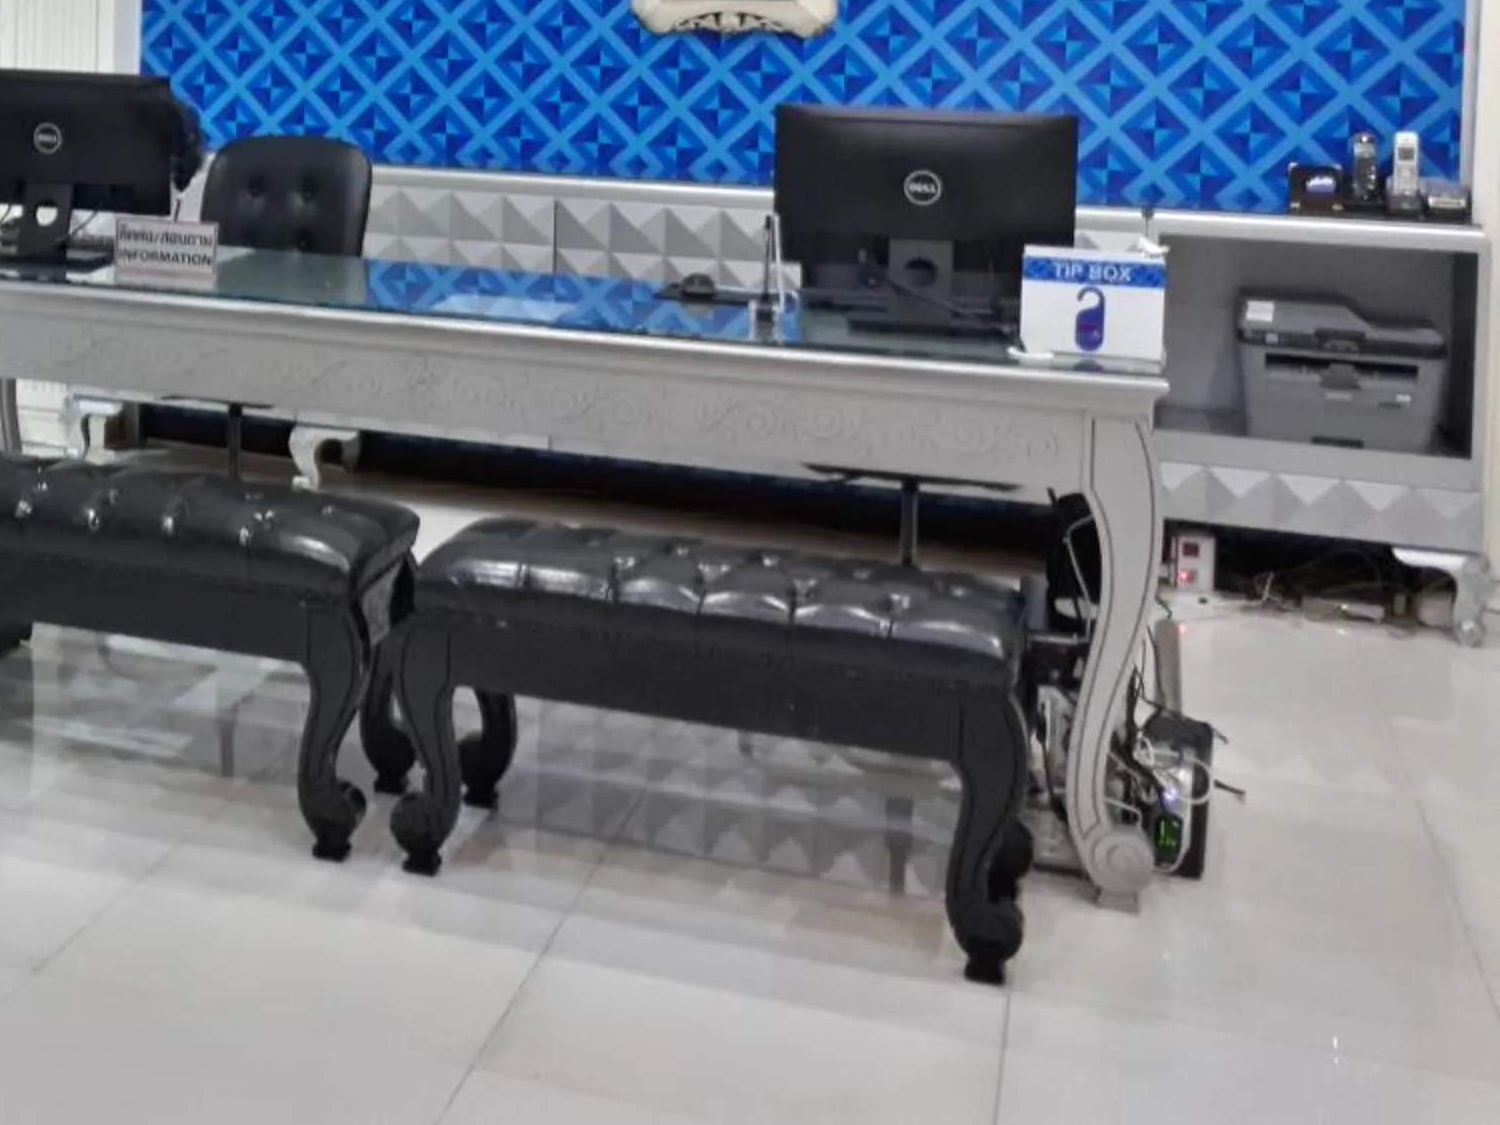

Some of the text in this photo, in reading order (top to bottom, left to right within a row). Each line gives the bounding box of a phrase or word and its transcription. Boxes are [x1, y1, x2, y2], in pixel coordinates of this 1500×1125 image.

[118, 247, 212, 266] INFORMATION
[1051, 261, 1133, 282] TIP BOX
